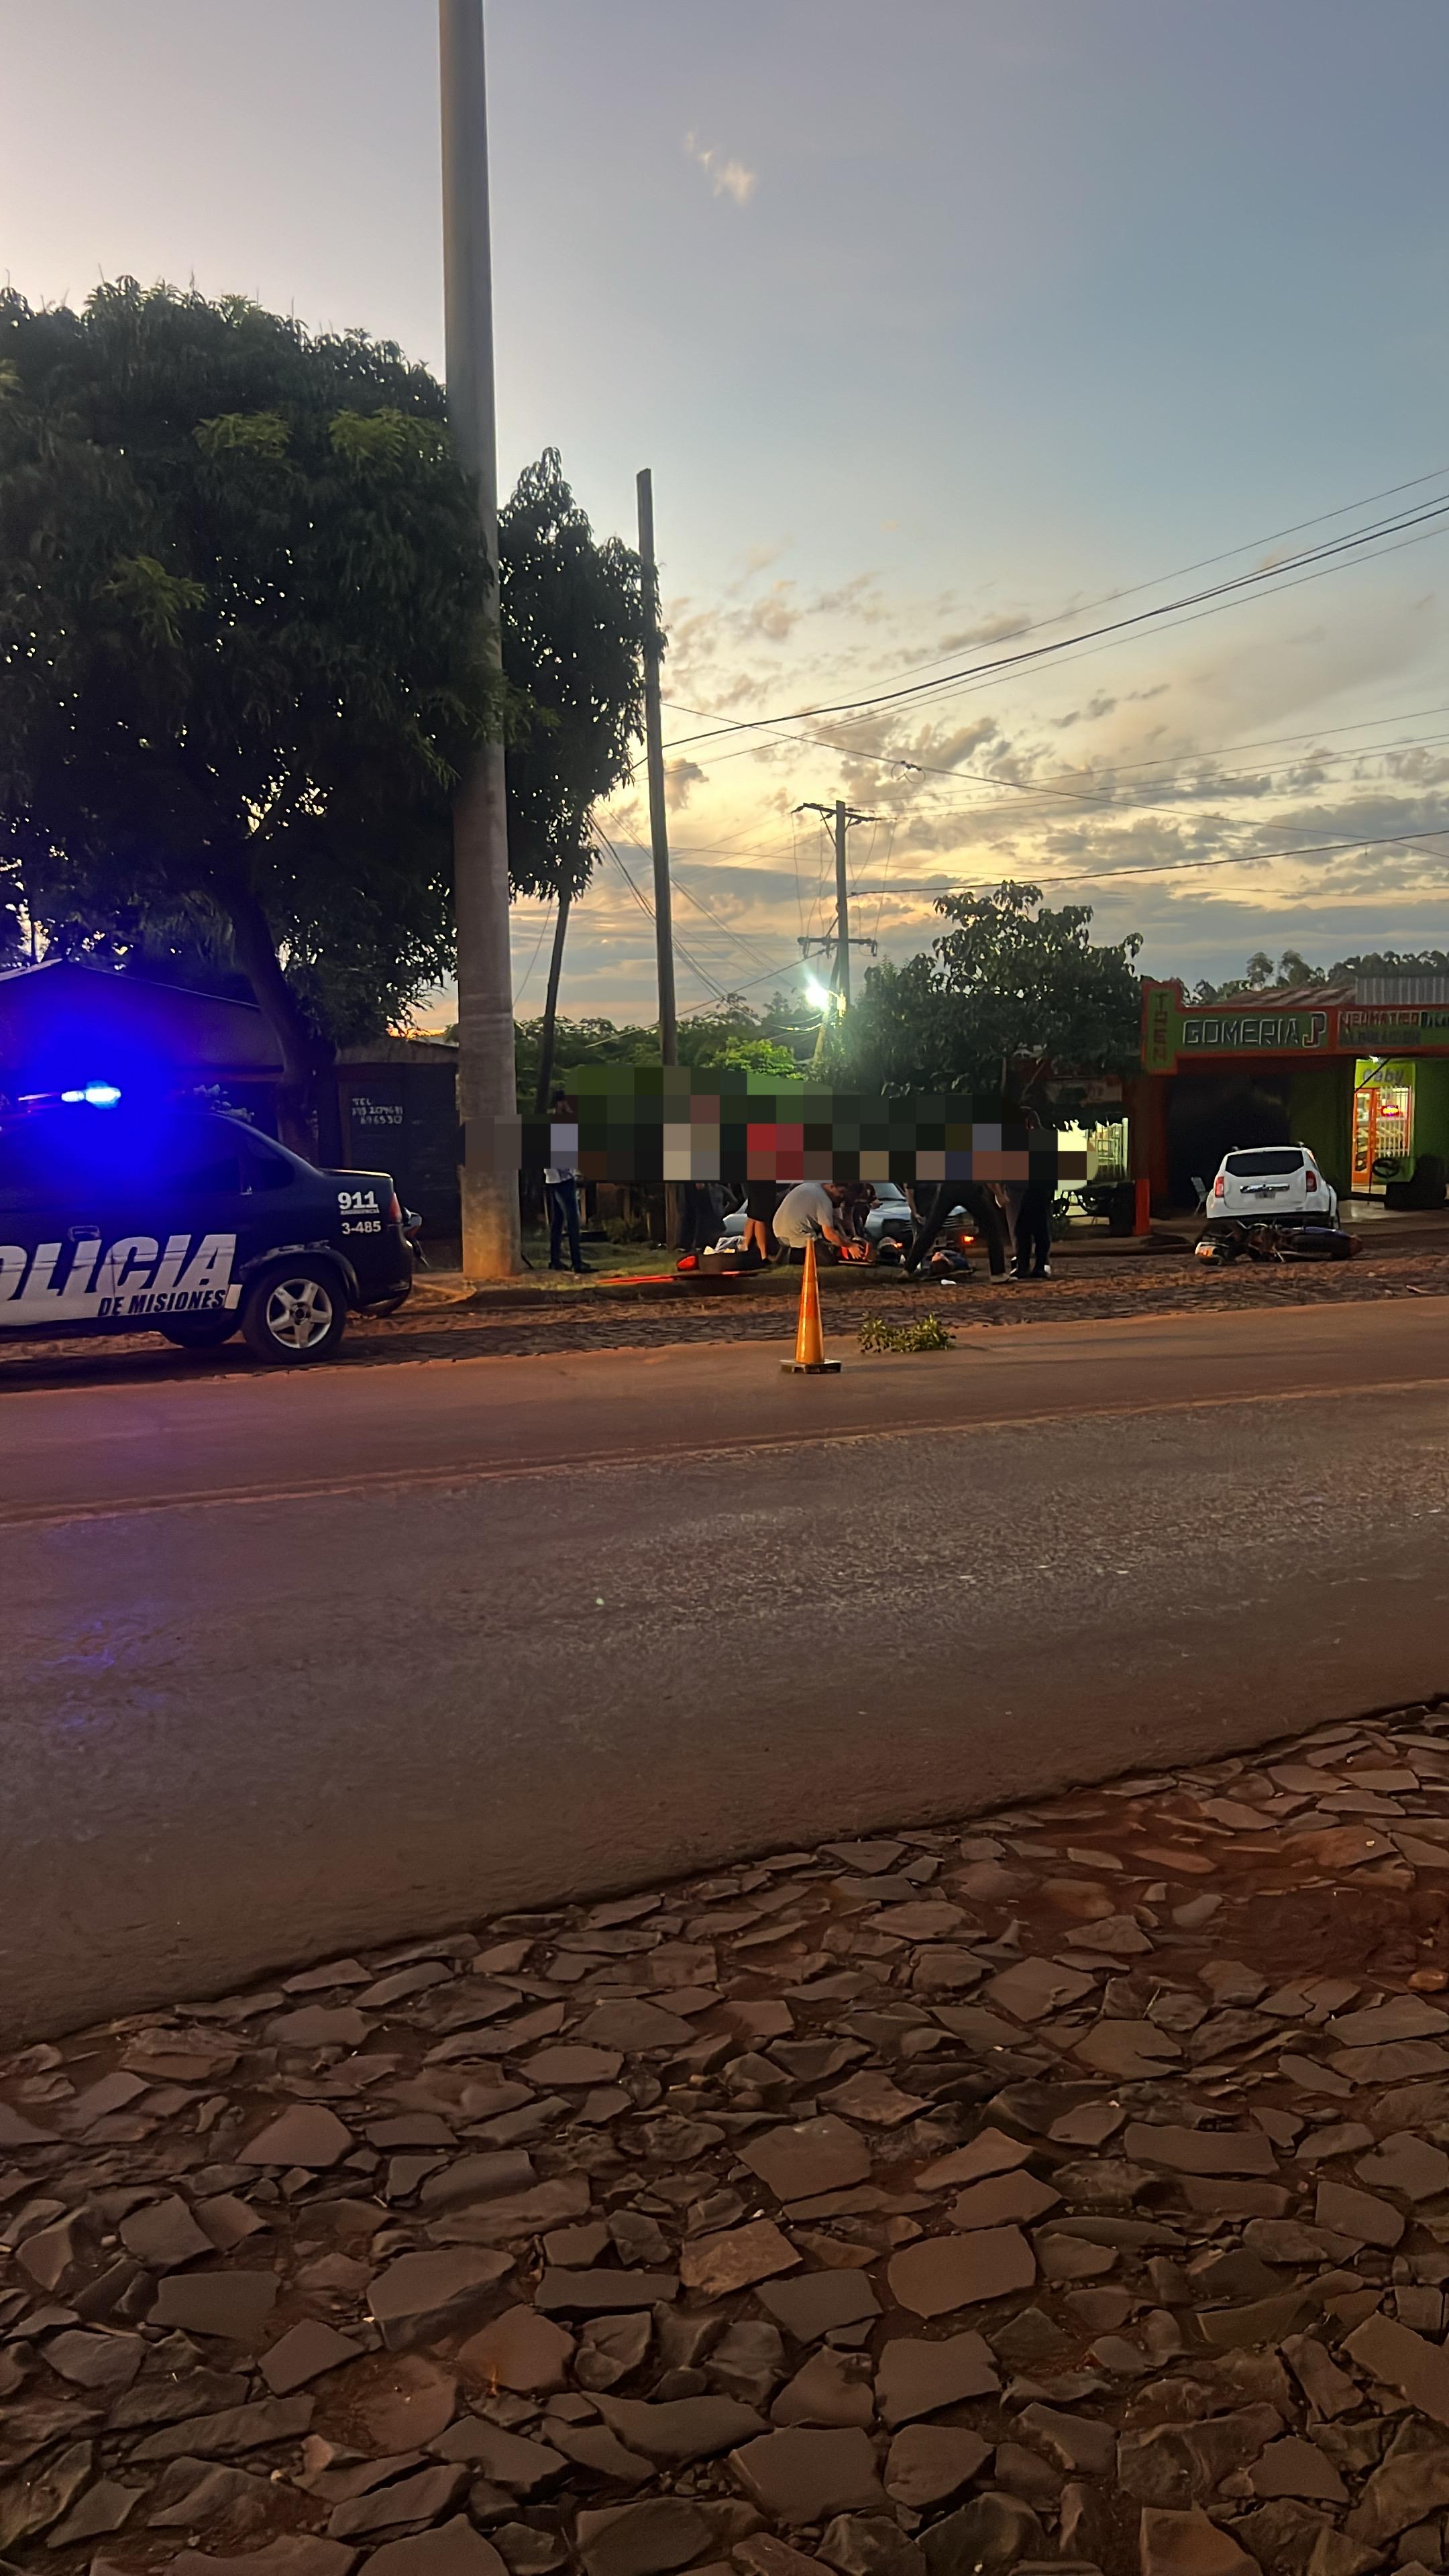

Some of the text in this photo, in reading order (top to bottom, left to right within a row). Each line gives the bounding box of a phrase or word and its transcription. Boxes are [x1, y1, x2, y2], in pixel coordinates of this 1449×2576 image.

[1183, 1018, 1299, 1046] GOMERIA
[337, 1191, 378, 1210] 911
[341, 1221, 381, 1234] 3-485
[99, 1289, 226, 1316] DE MISIONES
